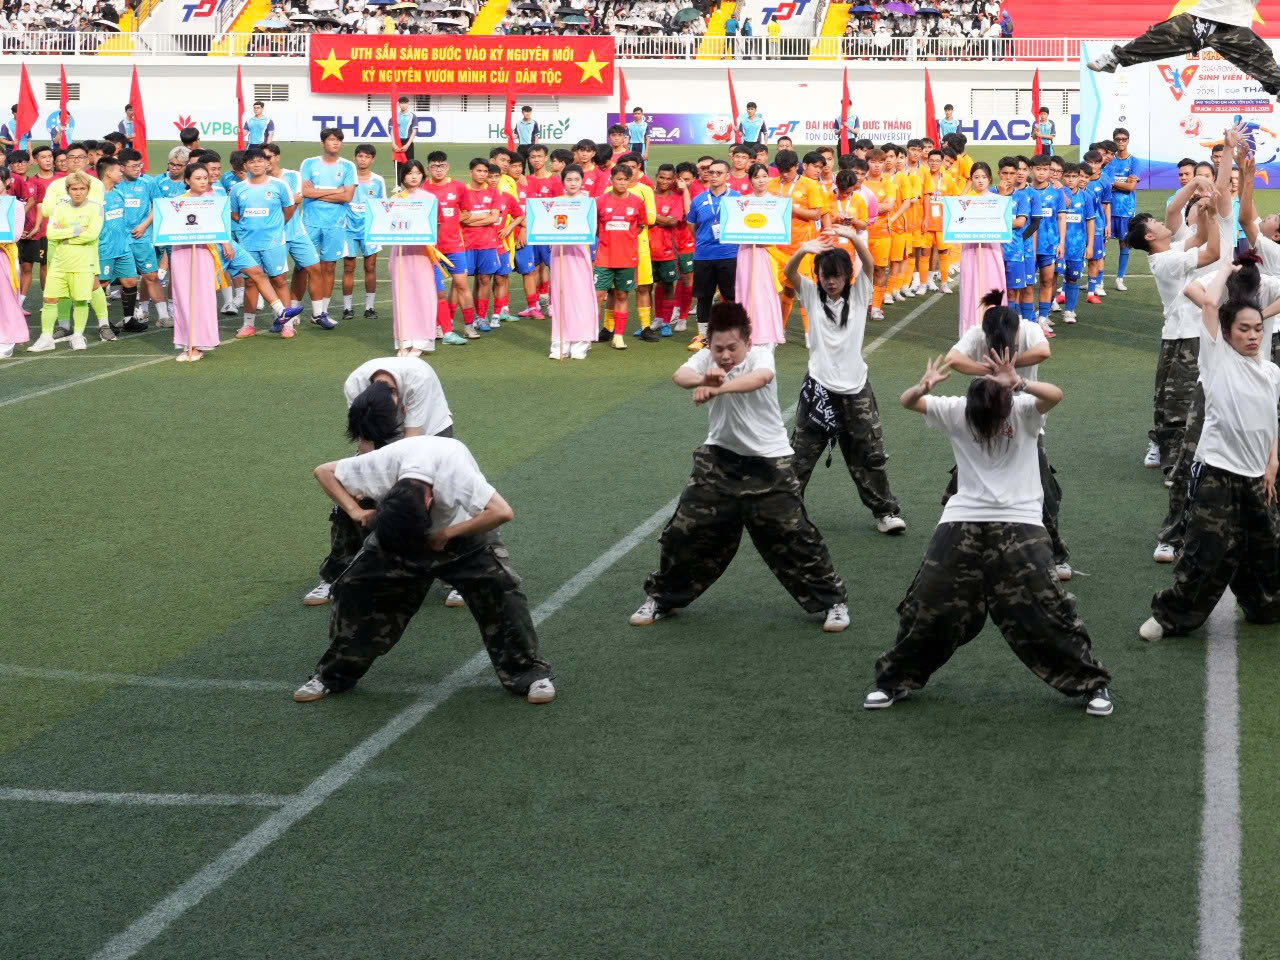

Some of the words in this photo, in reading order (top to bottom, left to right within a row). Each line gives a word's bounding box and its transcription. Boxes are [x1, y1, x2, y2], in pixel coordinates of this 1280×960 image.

[351, 47, 372, 60] UTH
[375, 43, 397, 60] SẴN
[400, 44, 428, 61] SÀNG
[432, 44, 461, 60] BƯỚC
[465, 44, 487, 61] VÀO
[490, 44, 504, 61] KỶ
[507, 46, 549, 61] NGUYÊN
[553, 45, 574, 61] MỚI
[362, 66, 375, 82] KỶ
[379, 68, 422, 83] NGUYÊN
[425, 69, 455, 83] VƯƠN
[458, 68, 487, 83] MÌNH
[515, 68, 537, 83] DÂN
[540, 67, 562, 85] TỘC
[868, 133, 912, 141] UNIVERSITY
[104, 265, 110, 275] 8
